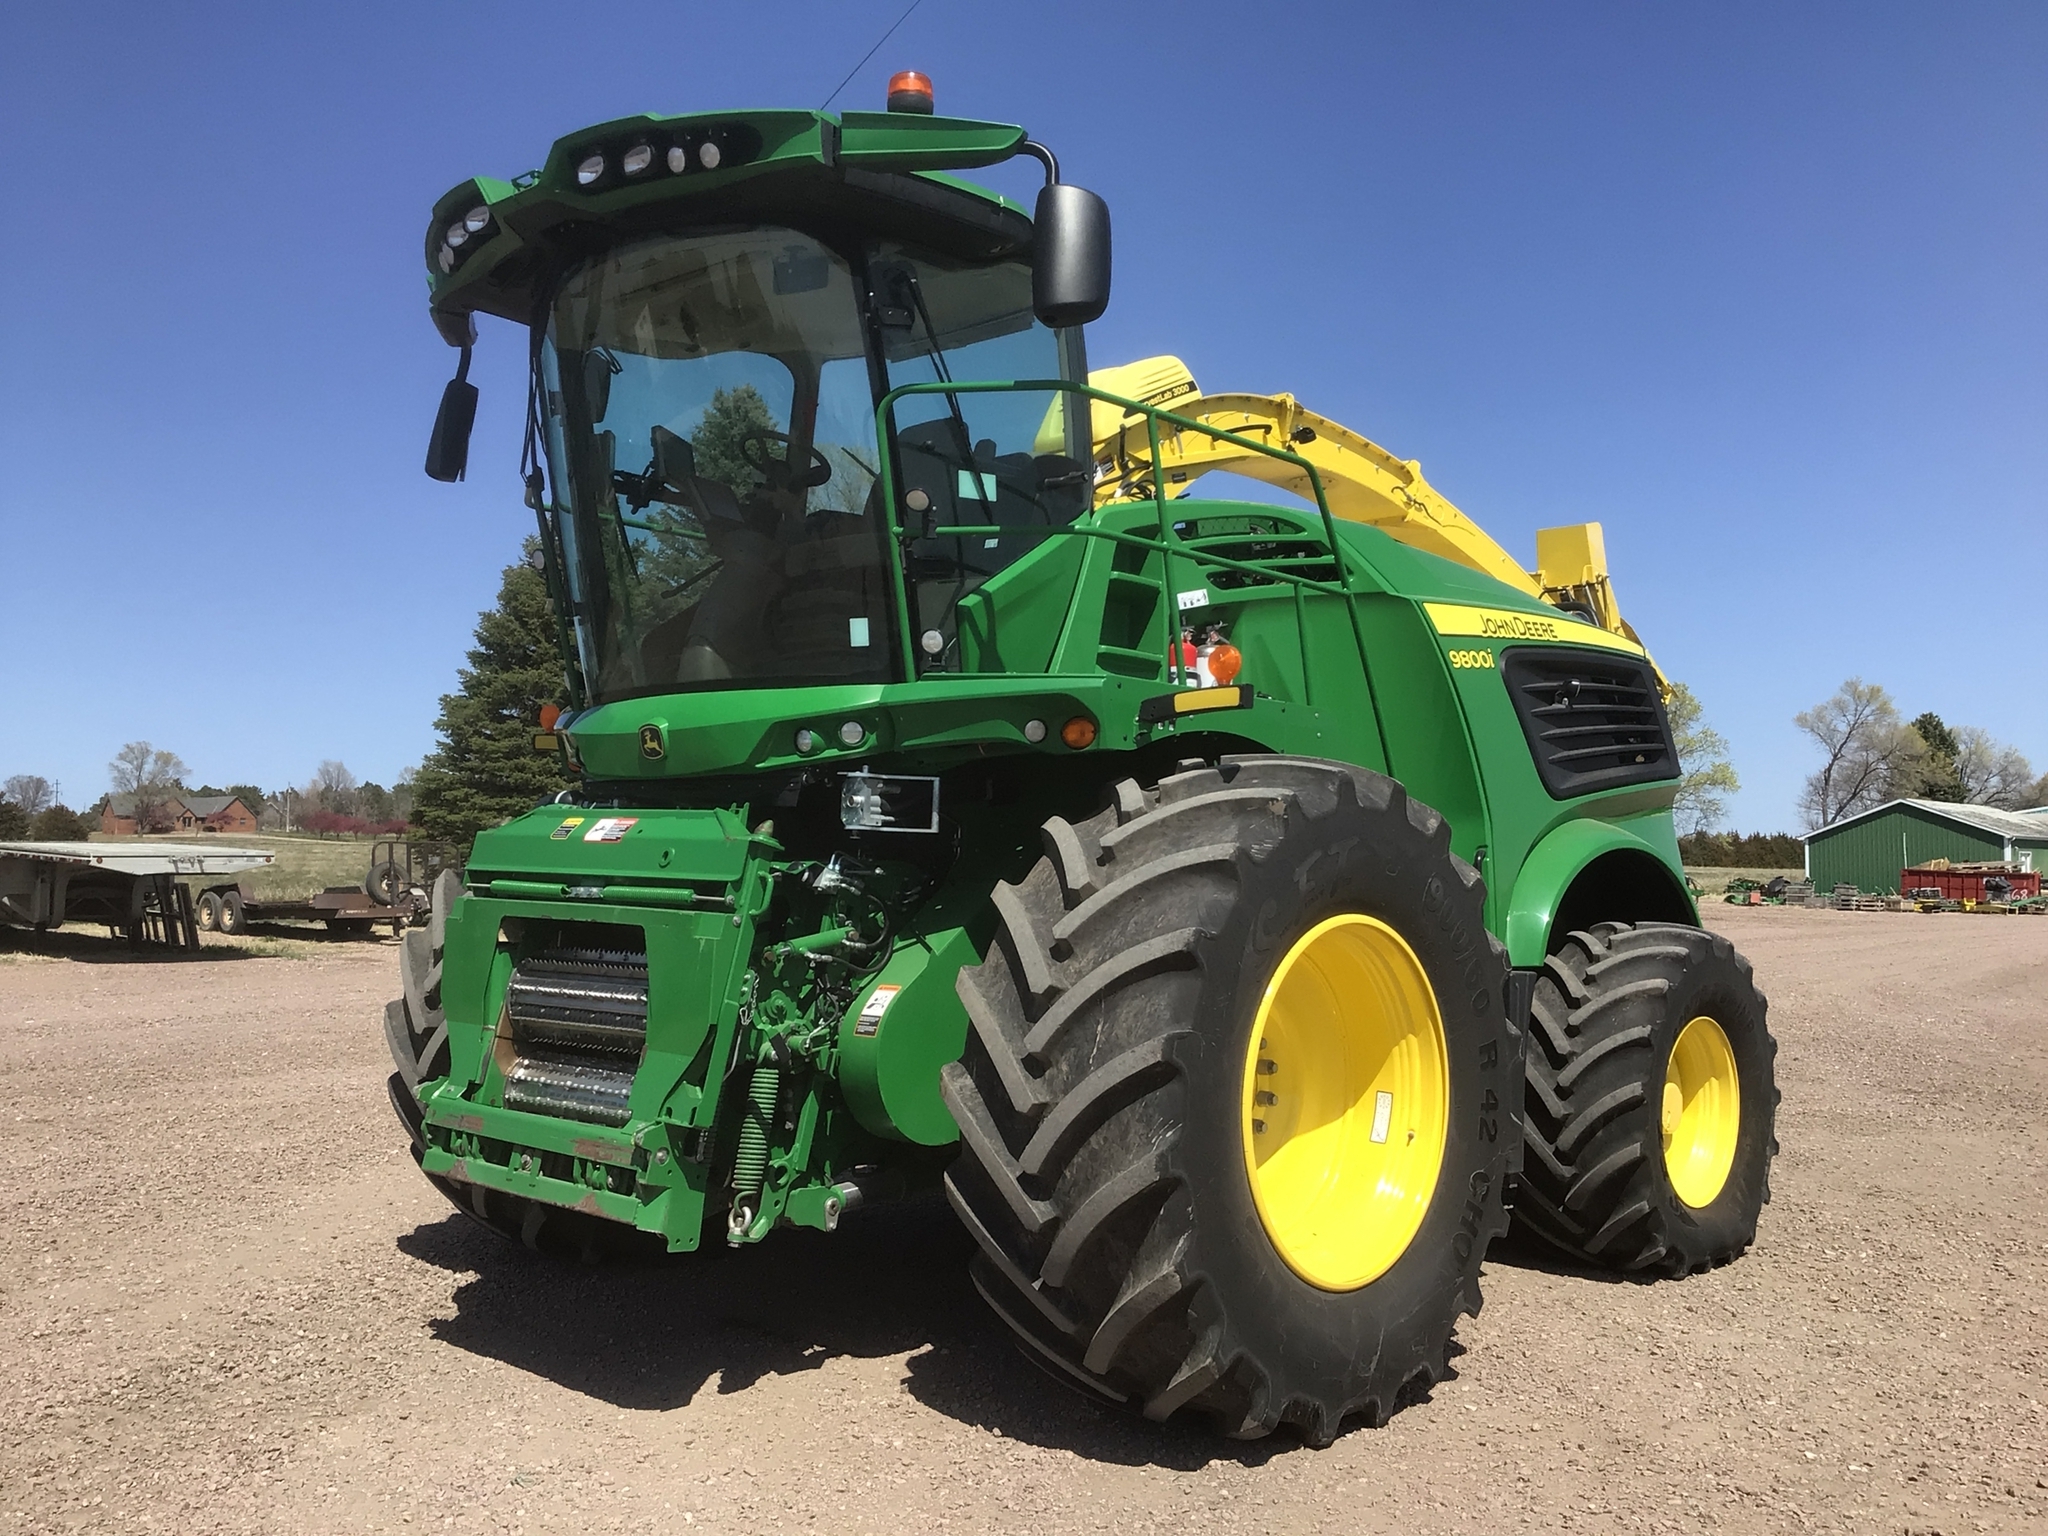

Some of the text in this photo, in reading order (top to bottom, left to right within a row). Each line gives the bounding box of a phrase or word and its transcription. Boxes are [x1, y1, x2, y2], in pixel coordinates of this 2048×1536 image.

[1172, 384, 1190, 396] 3000
[1479, 614, 1558, 639] JOHN DEERE
[1449, 648, 1495, 668] 9800i
[2011, 889, 2028, 900] 68
[1478, 1039, 1498, 1072] R
[1479, 1088, 1499, 1143] 42
